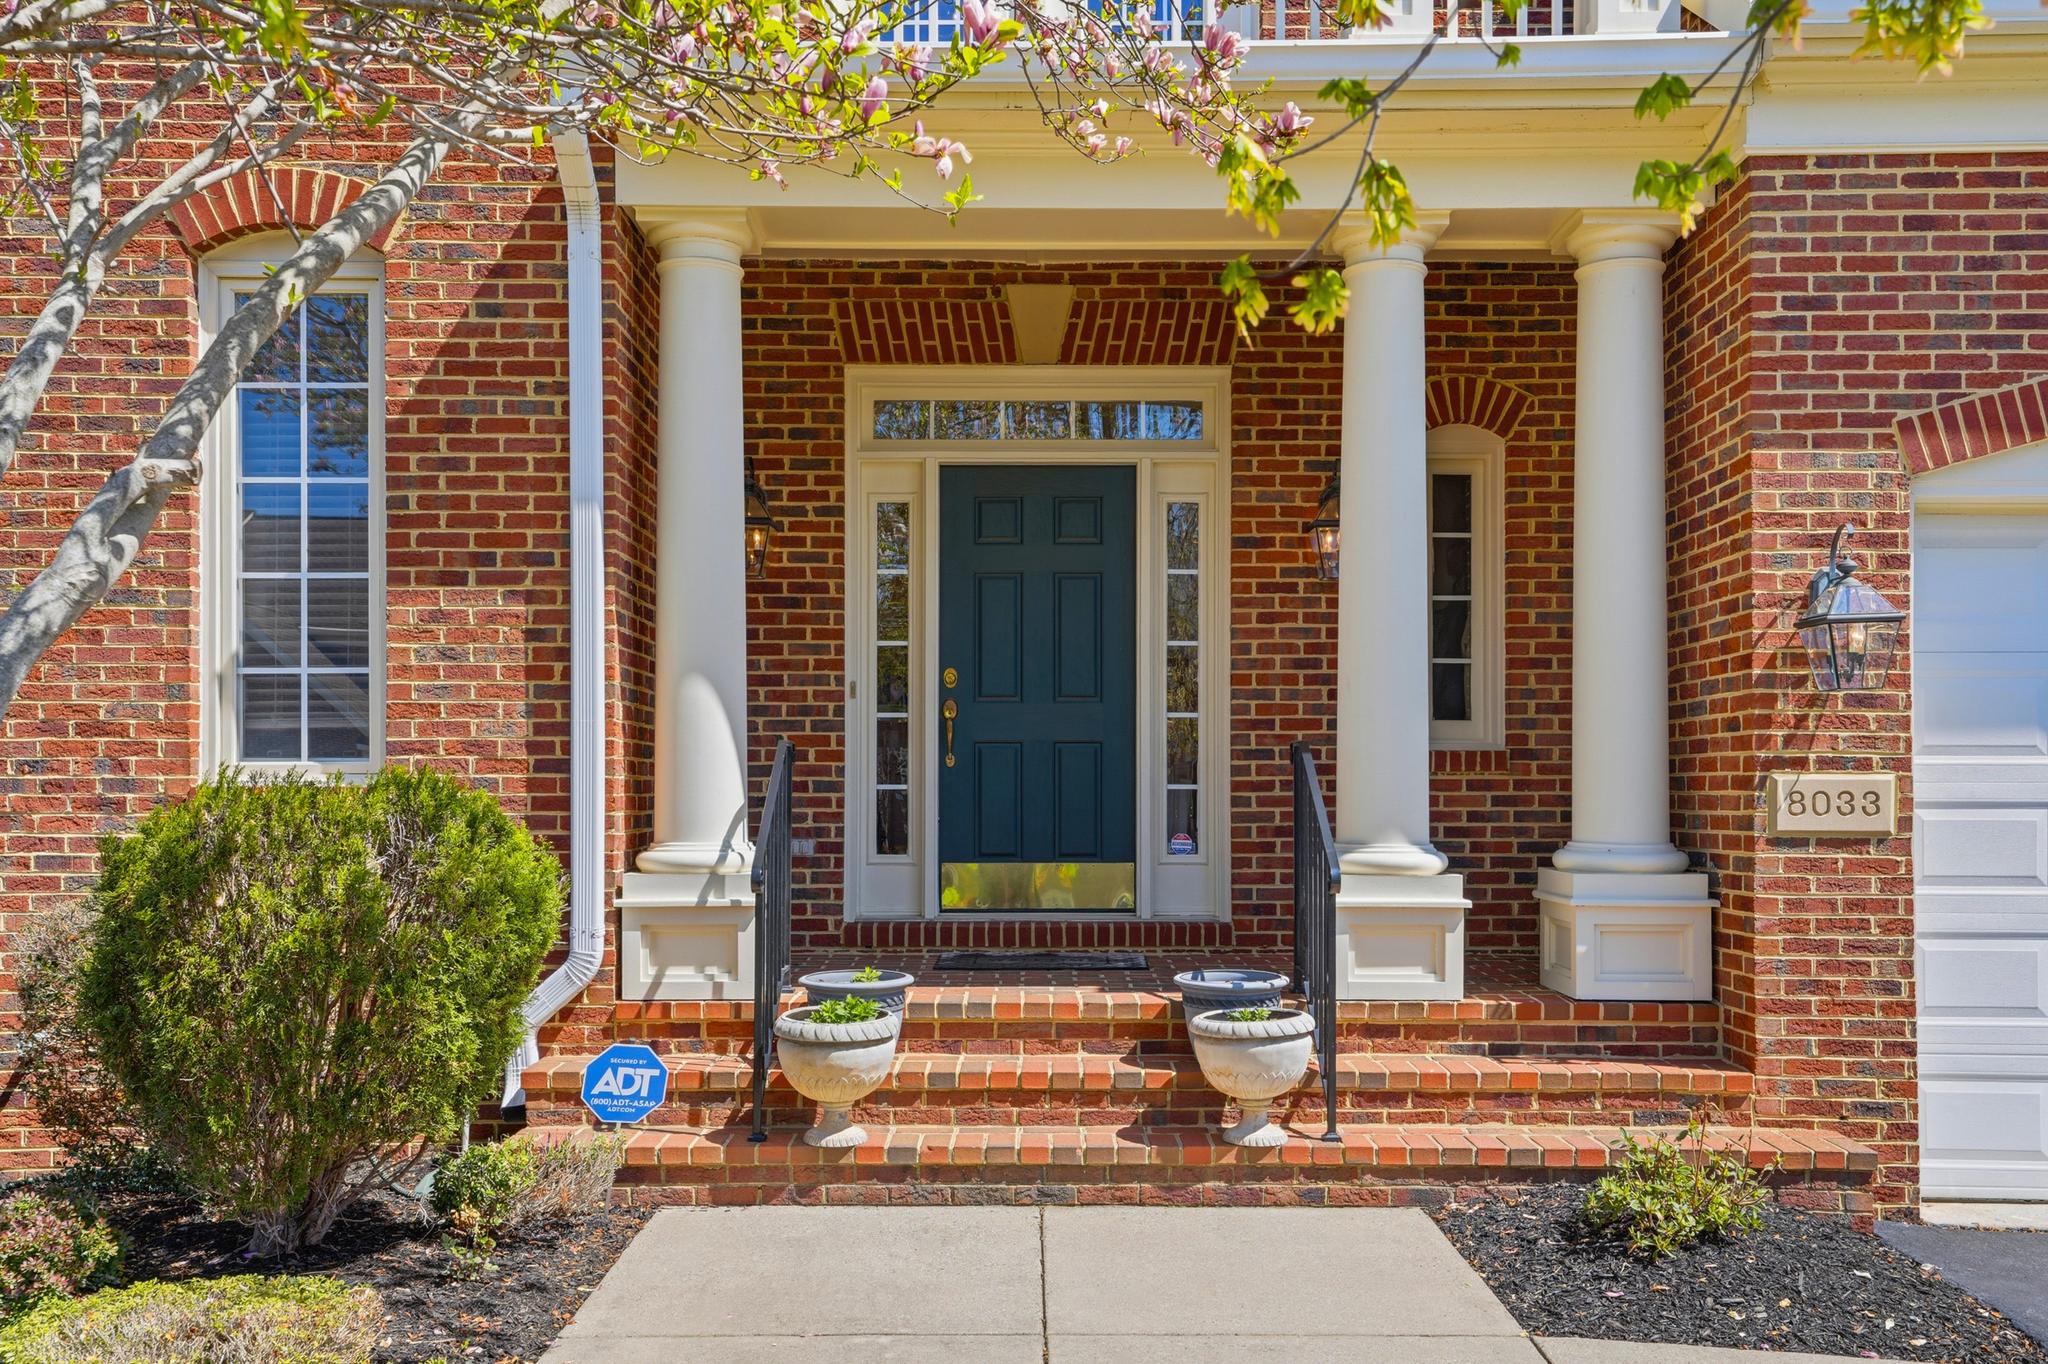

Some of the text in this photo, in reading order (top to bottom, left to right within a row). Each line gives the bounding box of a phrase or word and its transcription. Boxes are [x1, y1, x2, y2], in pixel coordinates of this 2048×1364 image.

[1788, 790, 1881, 817] 8033
[610, 1057, 638, 1065] SECURED
[590, 1067, 661, 1098] ADT
[612, 1099, 657, 1108] ADT-ASAP
